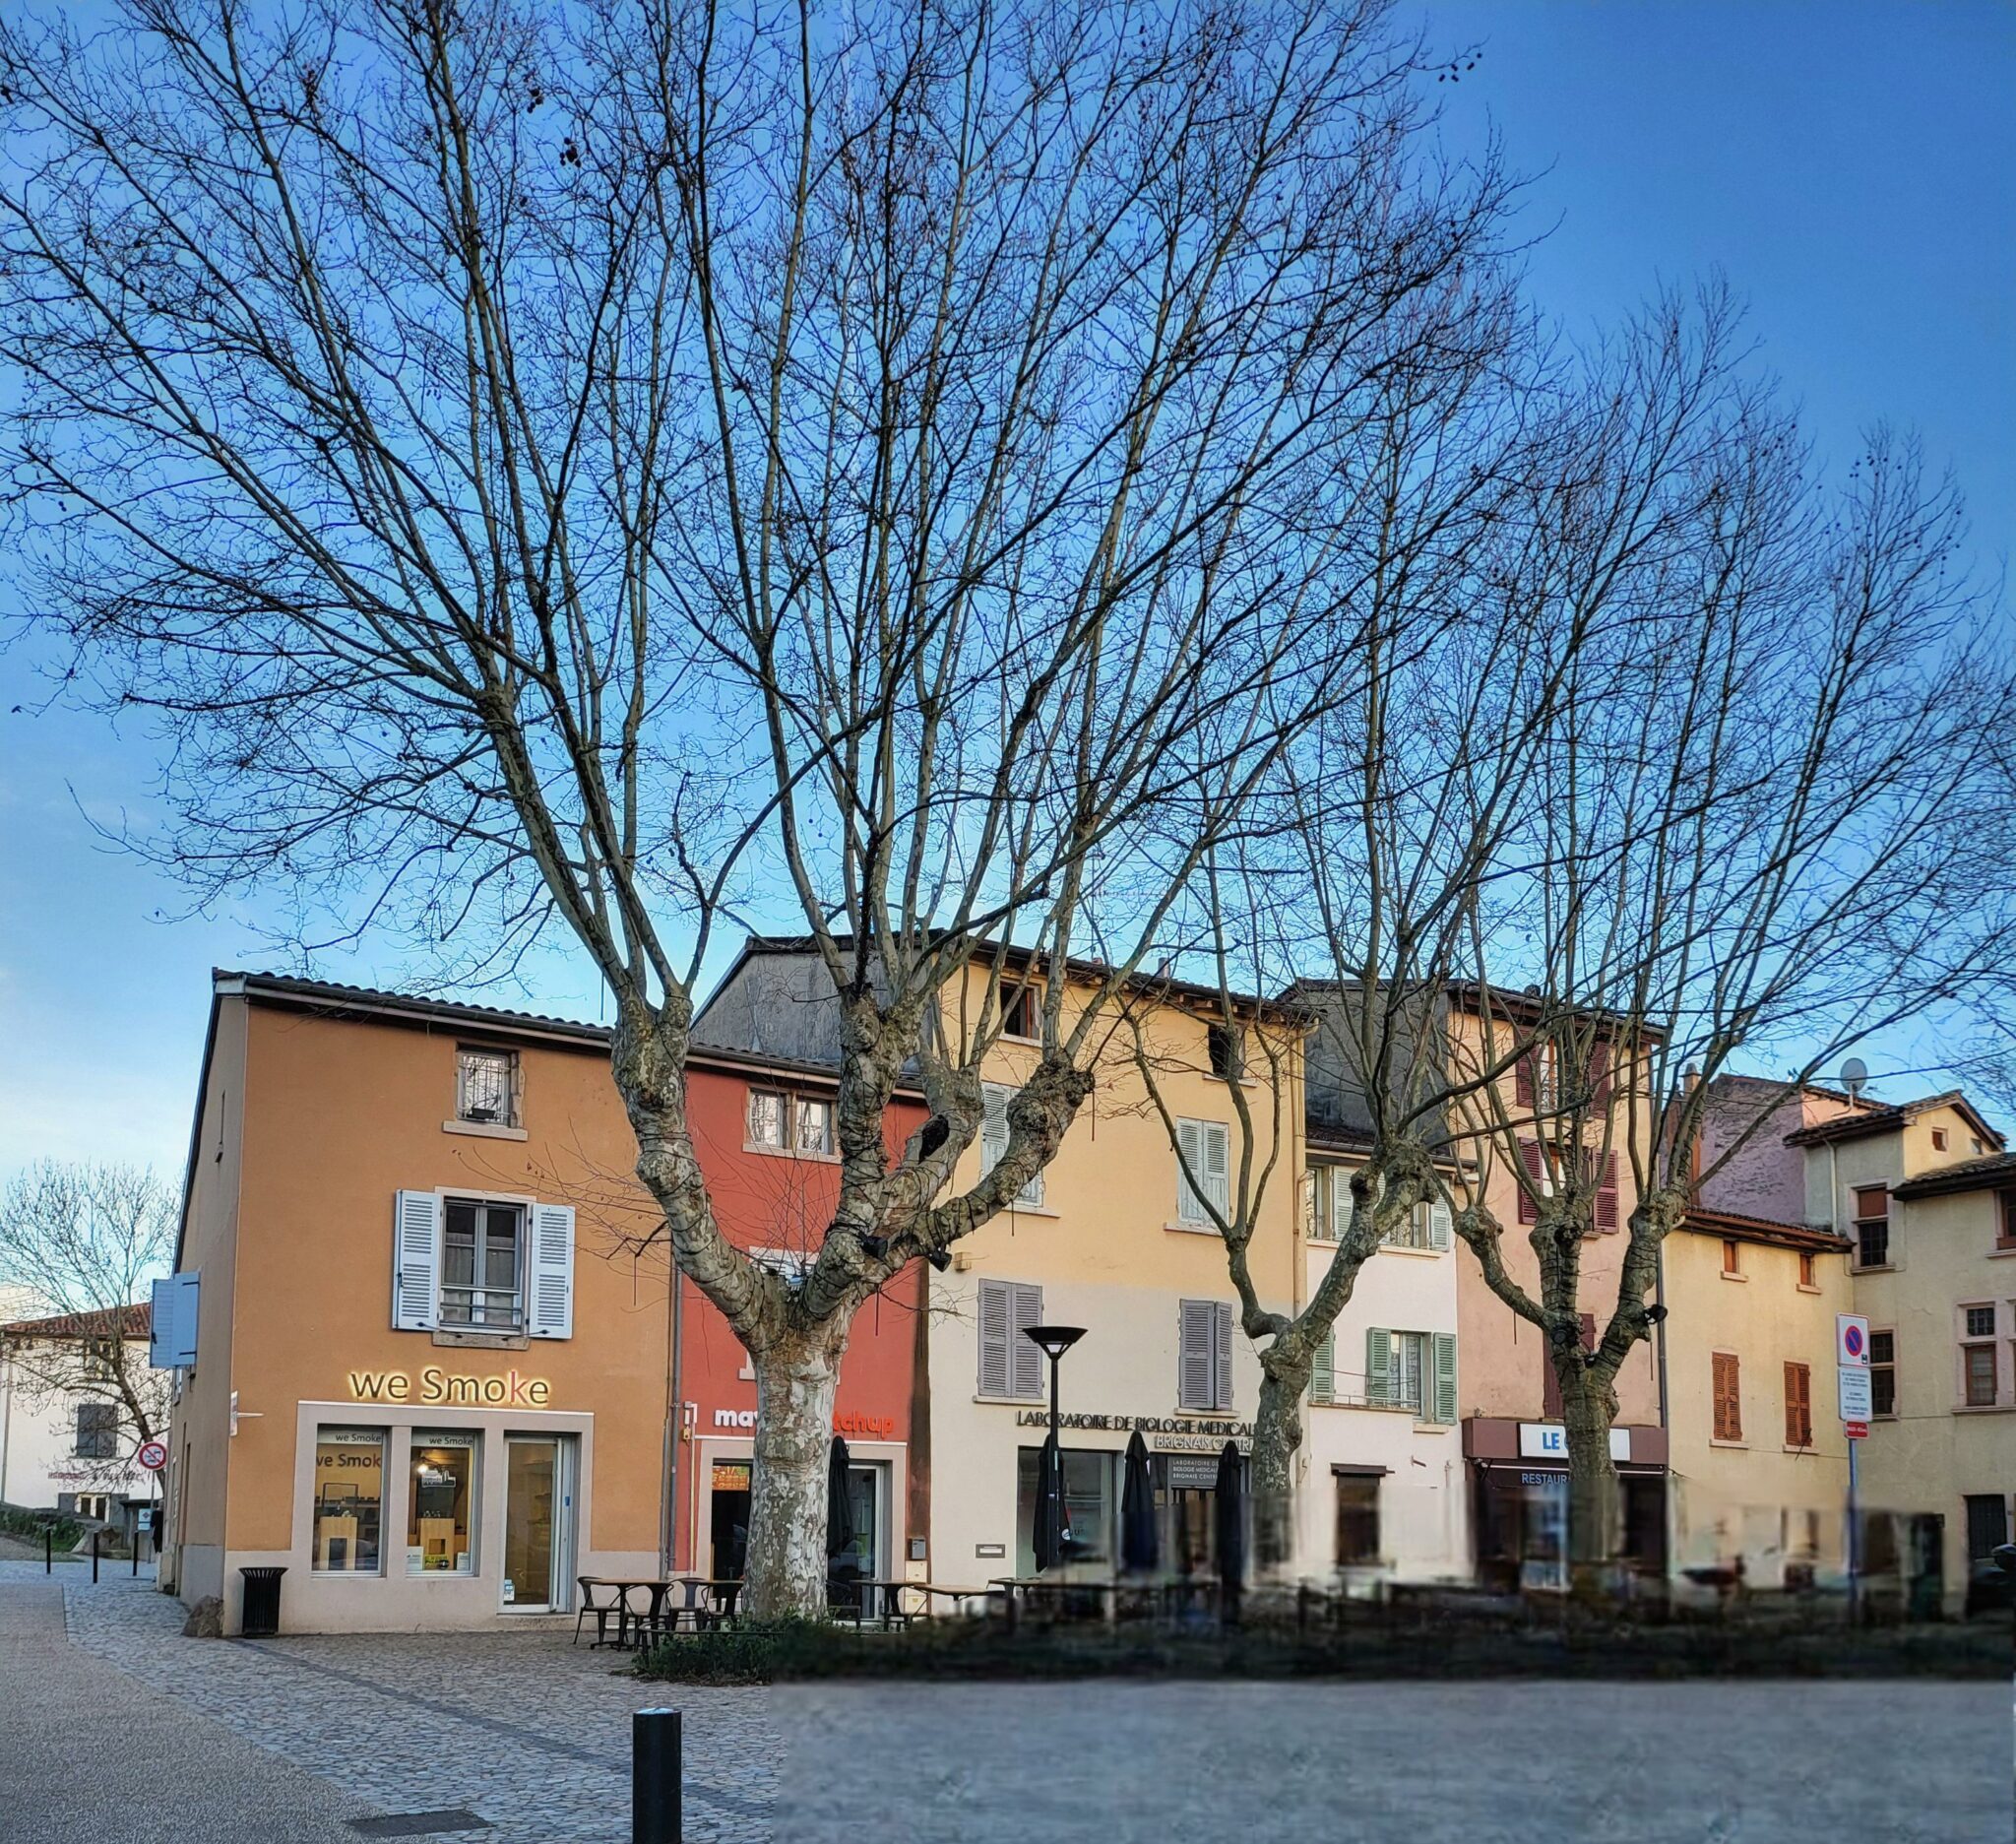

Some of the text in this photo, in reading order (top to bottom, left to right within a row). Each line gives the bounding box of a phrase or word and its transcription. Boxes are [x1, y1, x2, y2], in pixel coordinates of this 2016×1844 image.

[350, 1368, 548, 1404] we Smoke
[715, 1409, 758, 1428] ma
[1113, 1416, 1134, 1431] DE
[1135, 1418, 1196, 1434] BIOLOGIE
[336, 1432, 382, 1443] we Smoke
[444, 1436, 473, 1446] Smoke
[1156, 1436, 1210, 1450] BRIGNAIS
[1542, 1431, 1560, 1450] LE
[1521, 1473, 1571, 1485] RESTAUR
